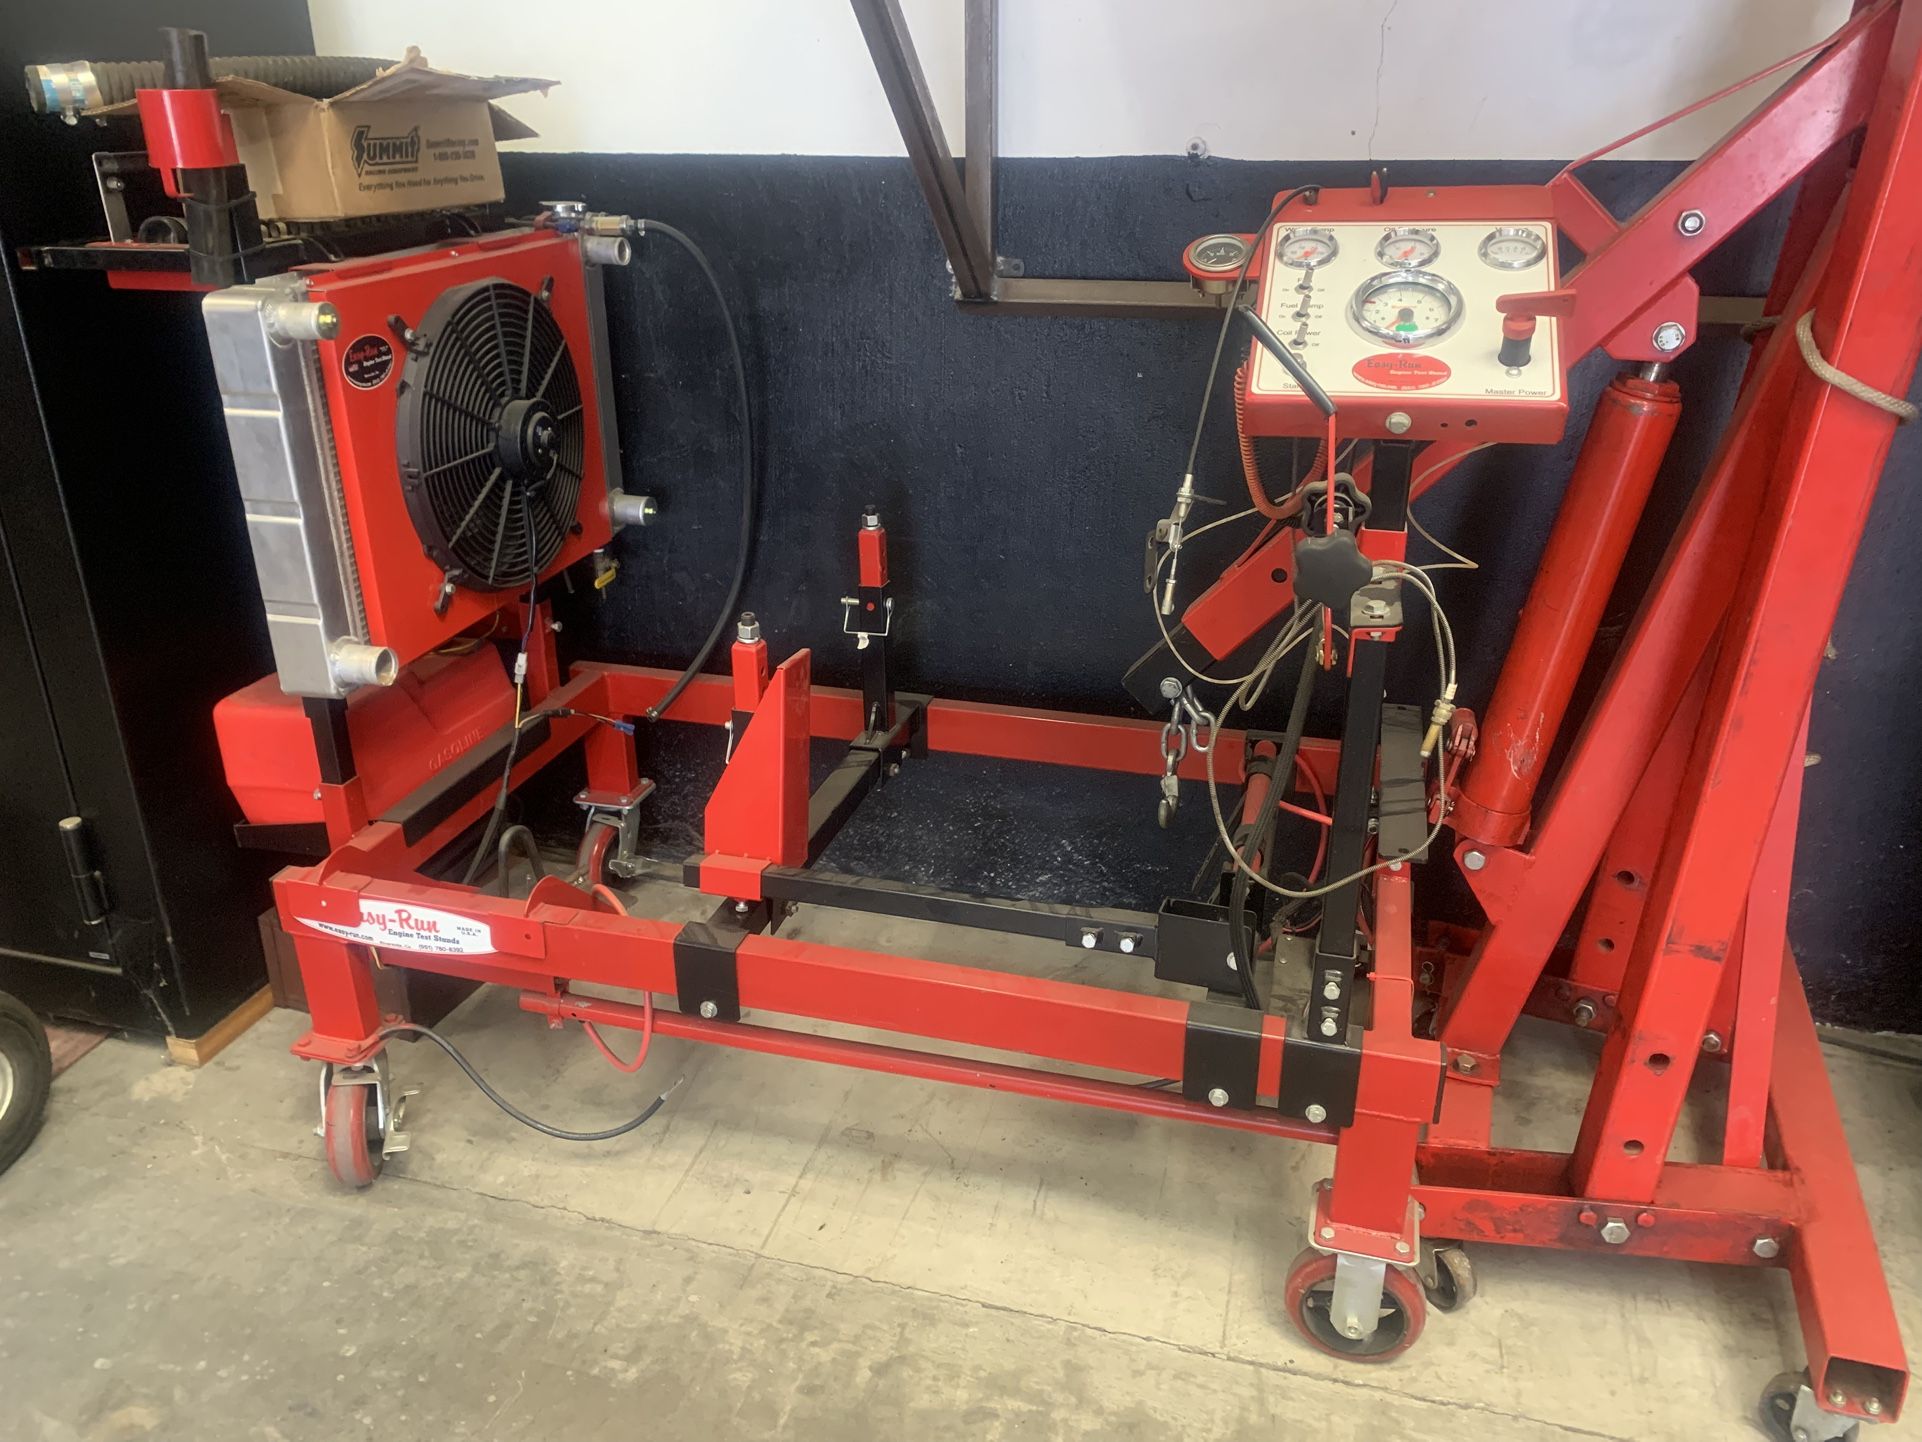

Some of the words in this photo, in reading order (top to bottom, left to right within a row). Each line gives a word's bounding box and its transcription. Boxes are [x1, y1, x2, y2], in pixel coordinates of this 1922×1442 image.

[388, 928, 414, 938] Engine
[415, 931, 431, 940] Test
[433, 934, 460, 945] Stands
